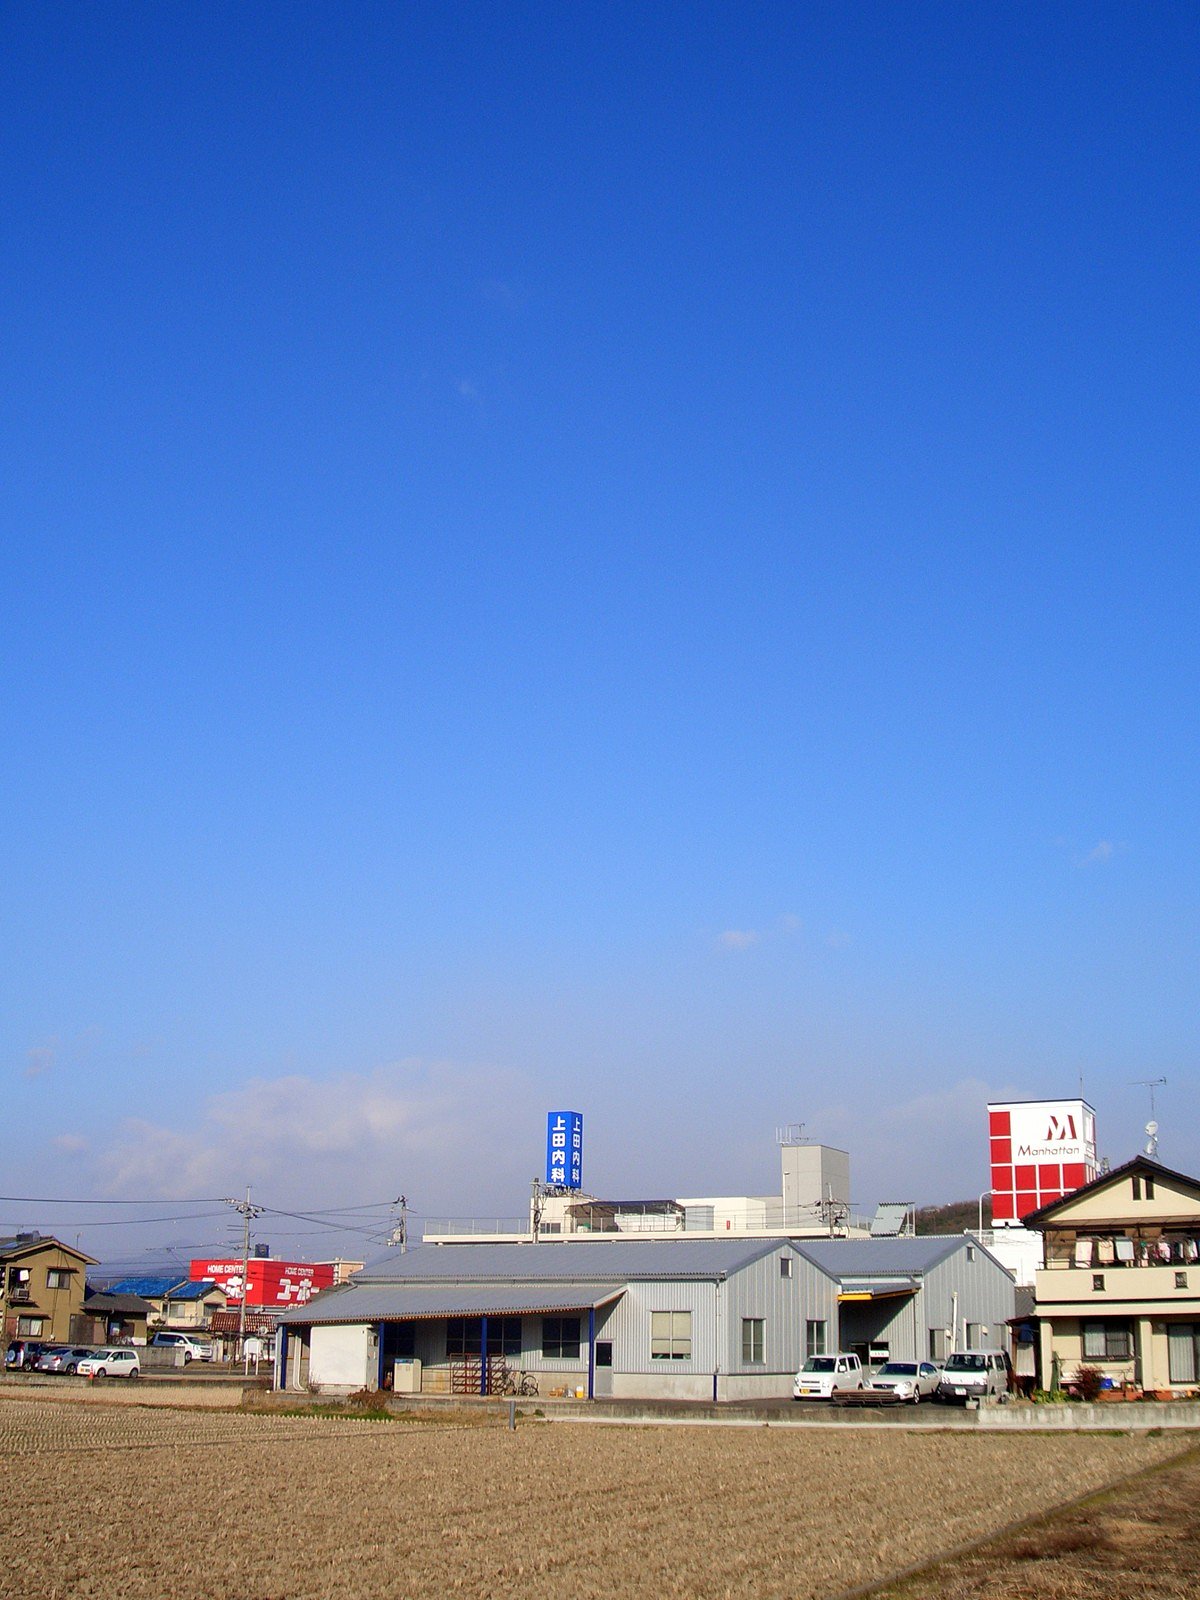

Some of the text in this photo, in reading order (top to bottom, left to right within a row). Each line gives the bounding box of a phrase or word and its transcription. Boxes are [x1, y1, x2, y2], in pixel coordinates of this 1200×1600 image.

[551, 1115, 566, 1183] 上田内科
[572, 1117, 581, 1184] 上田内科
[1018, 1145, 1080, 1157] Manhattan
[207, 1264, 245, 1274] HOME CENTE
[285, 1267, 298, 1275] HOME
